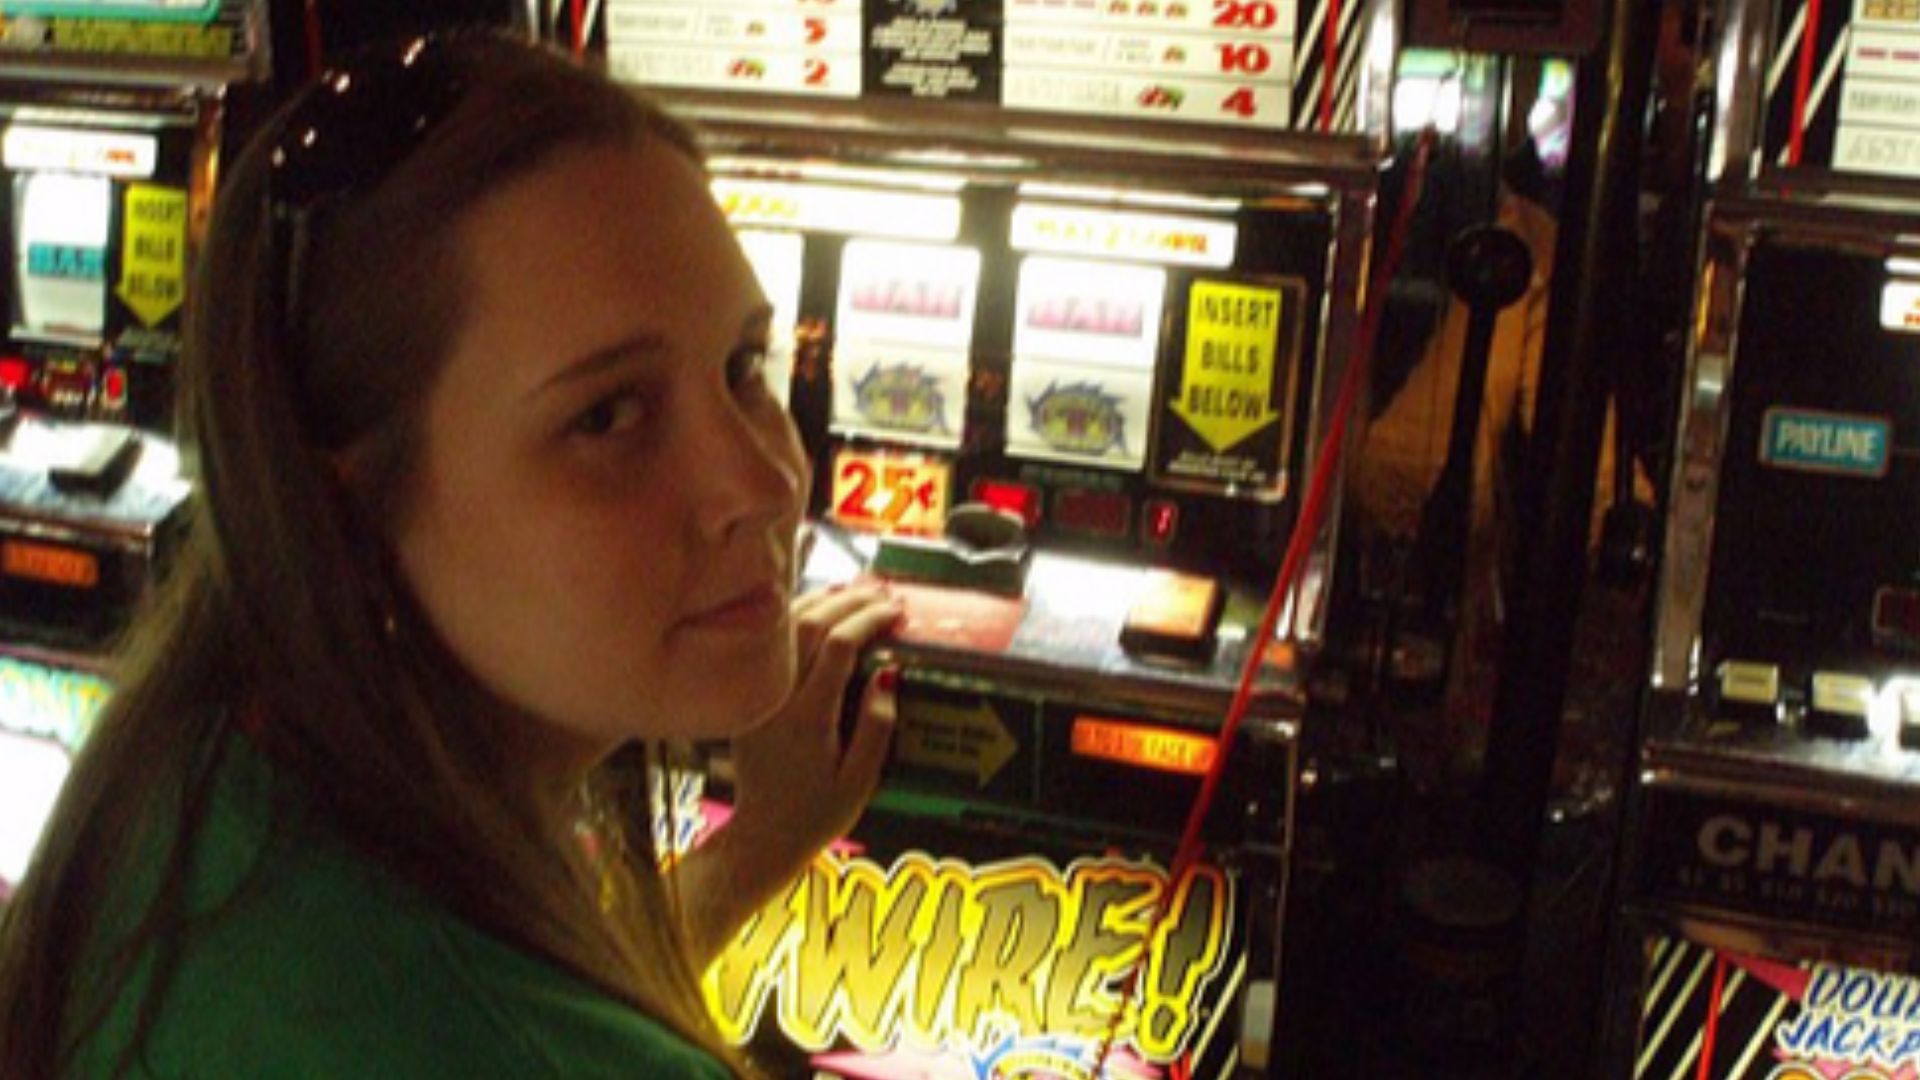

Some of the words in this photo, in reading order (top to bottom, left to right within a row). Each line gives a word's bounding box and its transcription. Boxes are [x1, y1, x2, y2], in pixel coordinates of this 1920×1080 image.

[1212, 0, 1277, 30] 20
[803, 59, 829, 87] 2
[1215, 43, 1271, 74] 10
[1221, 86, 1257, 118] 4
[1196, 295, 1276, 330] INSERT
[1202, 340, 1260, 375] BILLS
[1188, 383, 1266, 421] BELOW
[1775, 419, 1878, 463] PAYLINE
